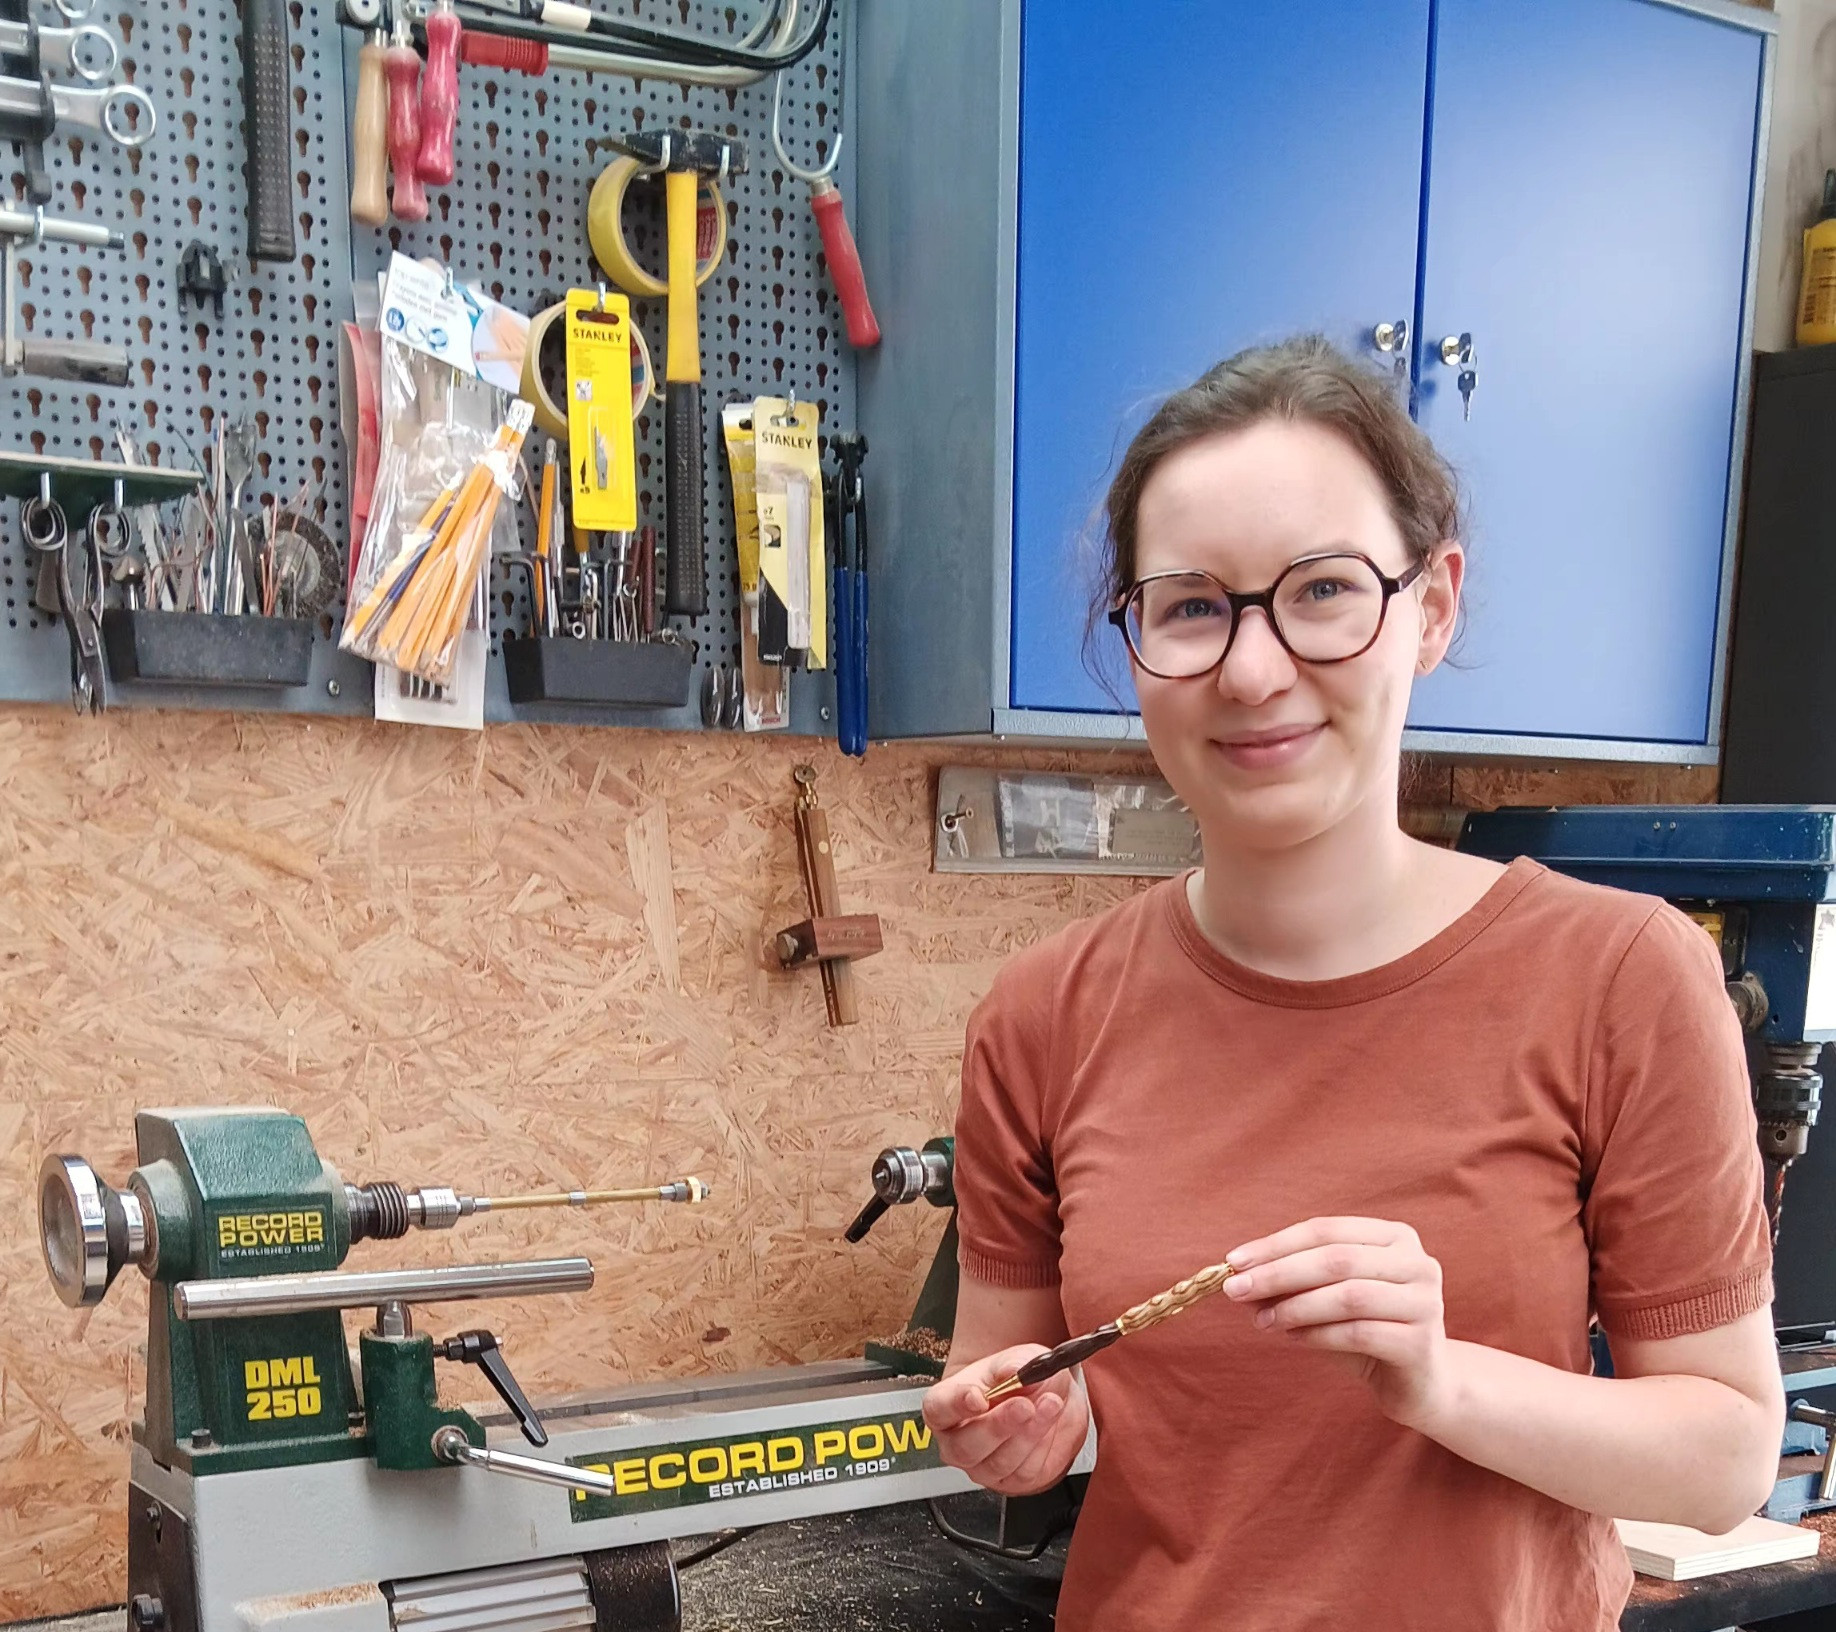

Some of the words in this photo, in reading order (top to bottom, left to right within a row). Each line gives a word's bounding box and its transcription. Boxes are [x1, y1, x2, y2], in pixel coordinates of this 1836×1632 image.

[573, 328, 622, 343] STANLEY
[761, 432, 813, 450] STANLEY
[218, 1211, 322, 1233] RECORD
[220, 1227, 324, 1248] POWER
[221, 1245, 292, 1258] ESTABLISHED
[244, 1355, 321, 1390] DML
[246, 1386, 322, 1421] 250
[813, 1419, 933, 1465] POW
[709, 1467, 838, 1498] ESTABLISHED
